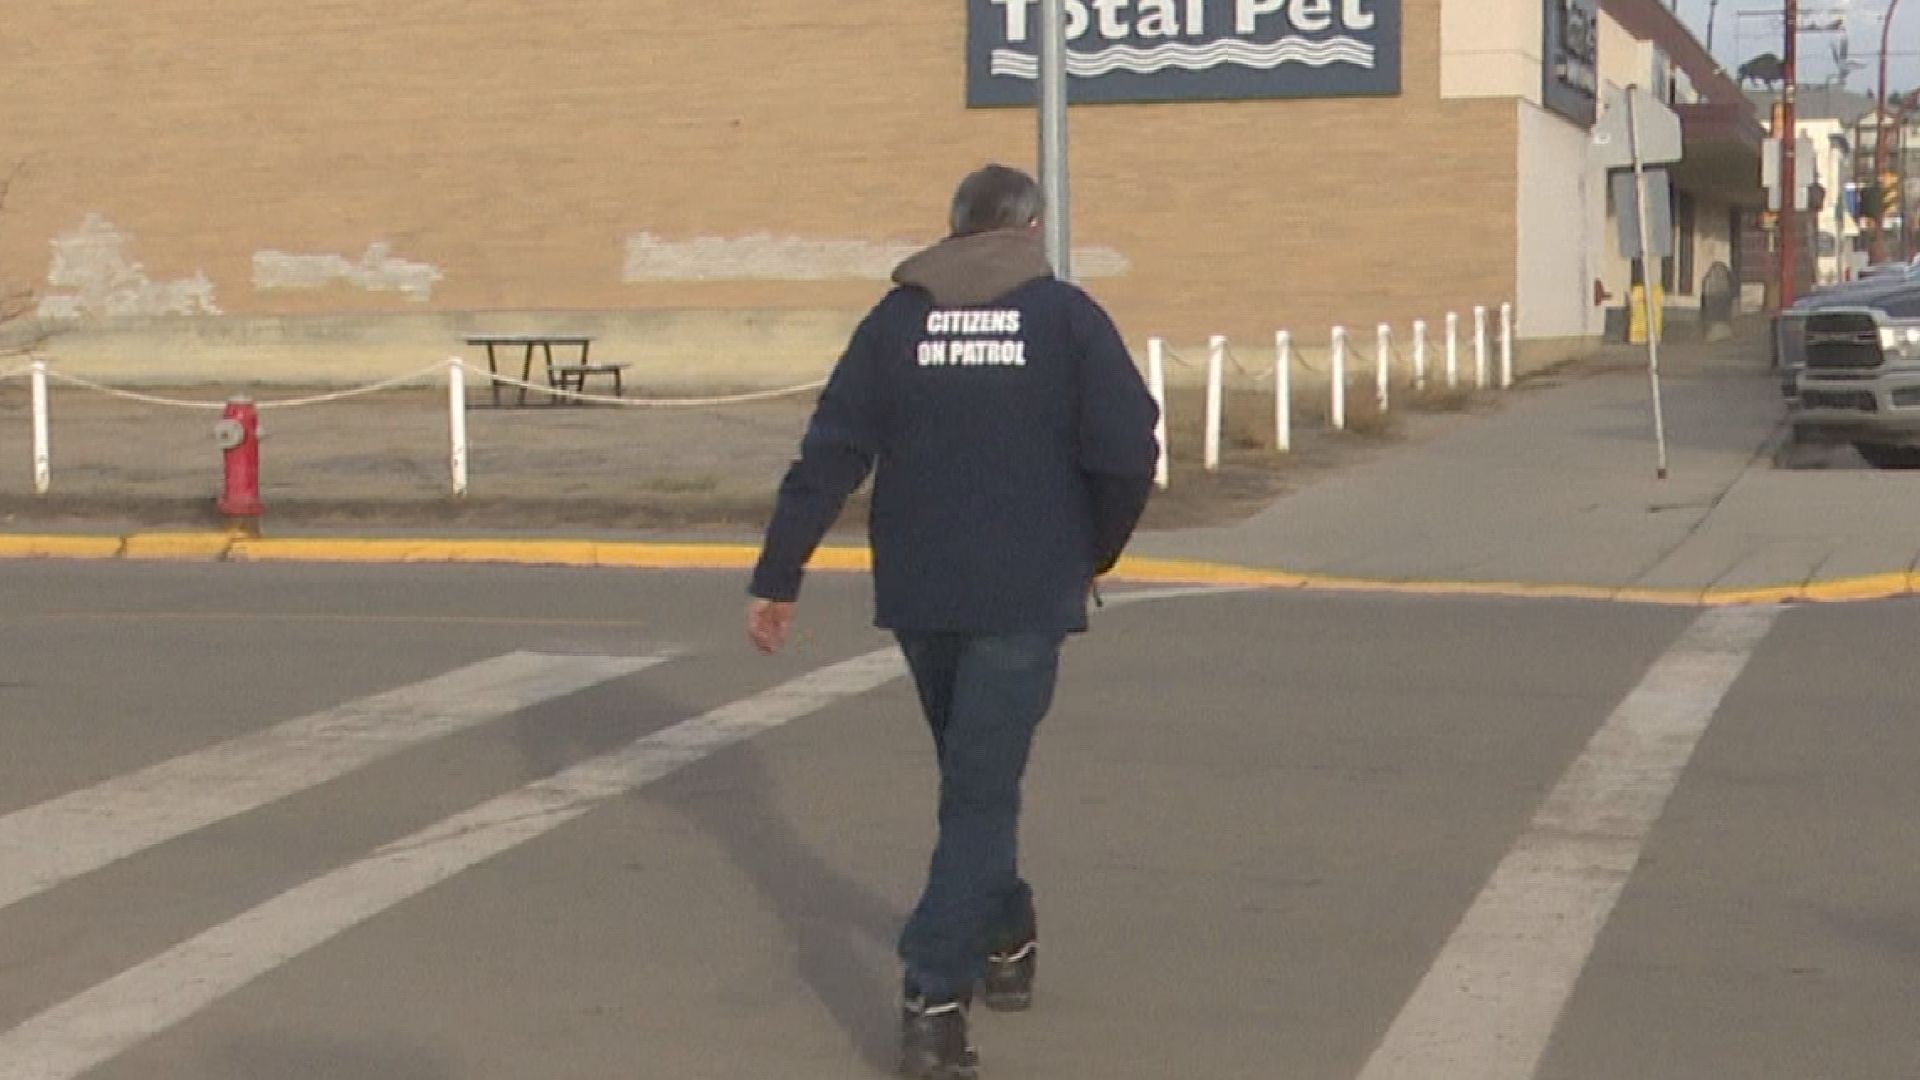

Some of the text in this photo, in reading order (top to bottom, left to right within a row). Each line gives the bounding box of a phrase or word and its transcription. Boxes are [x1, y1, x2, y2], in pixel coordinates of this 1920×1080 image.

[927, 310, 1021, 334] CITIZENS
[917, 341, 1026, 366] ON PATROL
